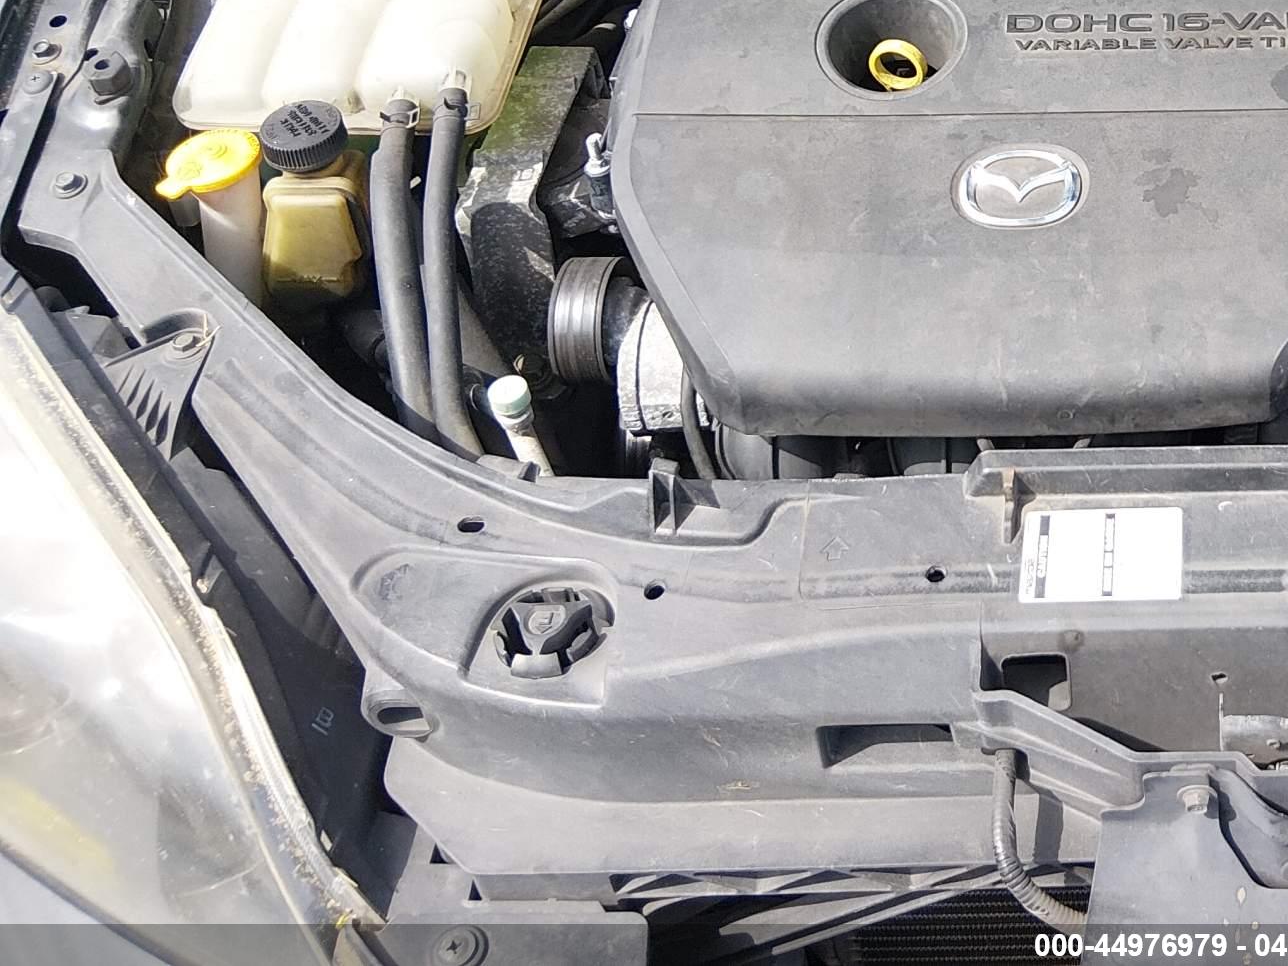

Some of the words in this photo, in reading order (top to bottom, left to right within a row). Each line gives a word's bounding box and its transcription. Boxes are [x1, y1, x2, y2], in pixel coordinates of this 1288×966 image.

[1006, 13, 1153, 34] DOHC
[1015, 37, 1157, 51] VARIABLE
[1164, 36, 1255, 50] VALVE
